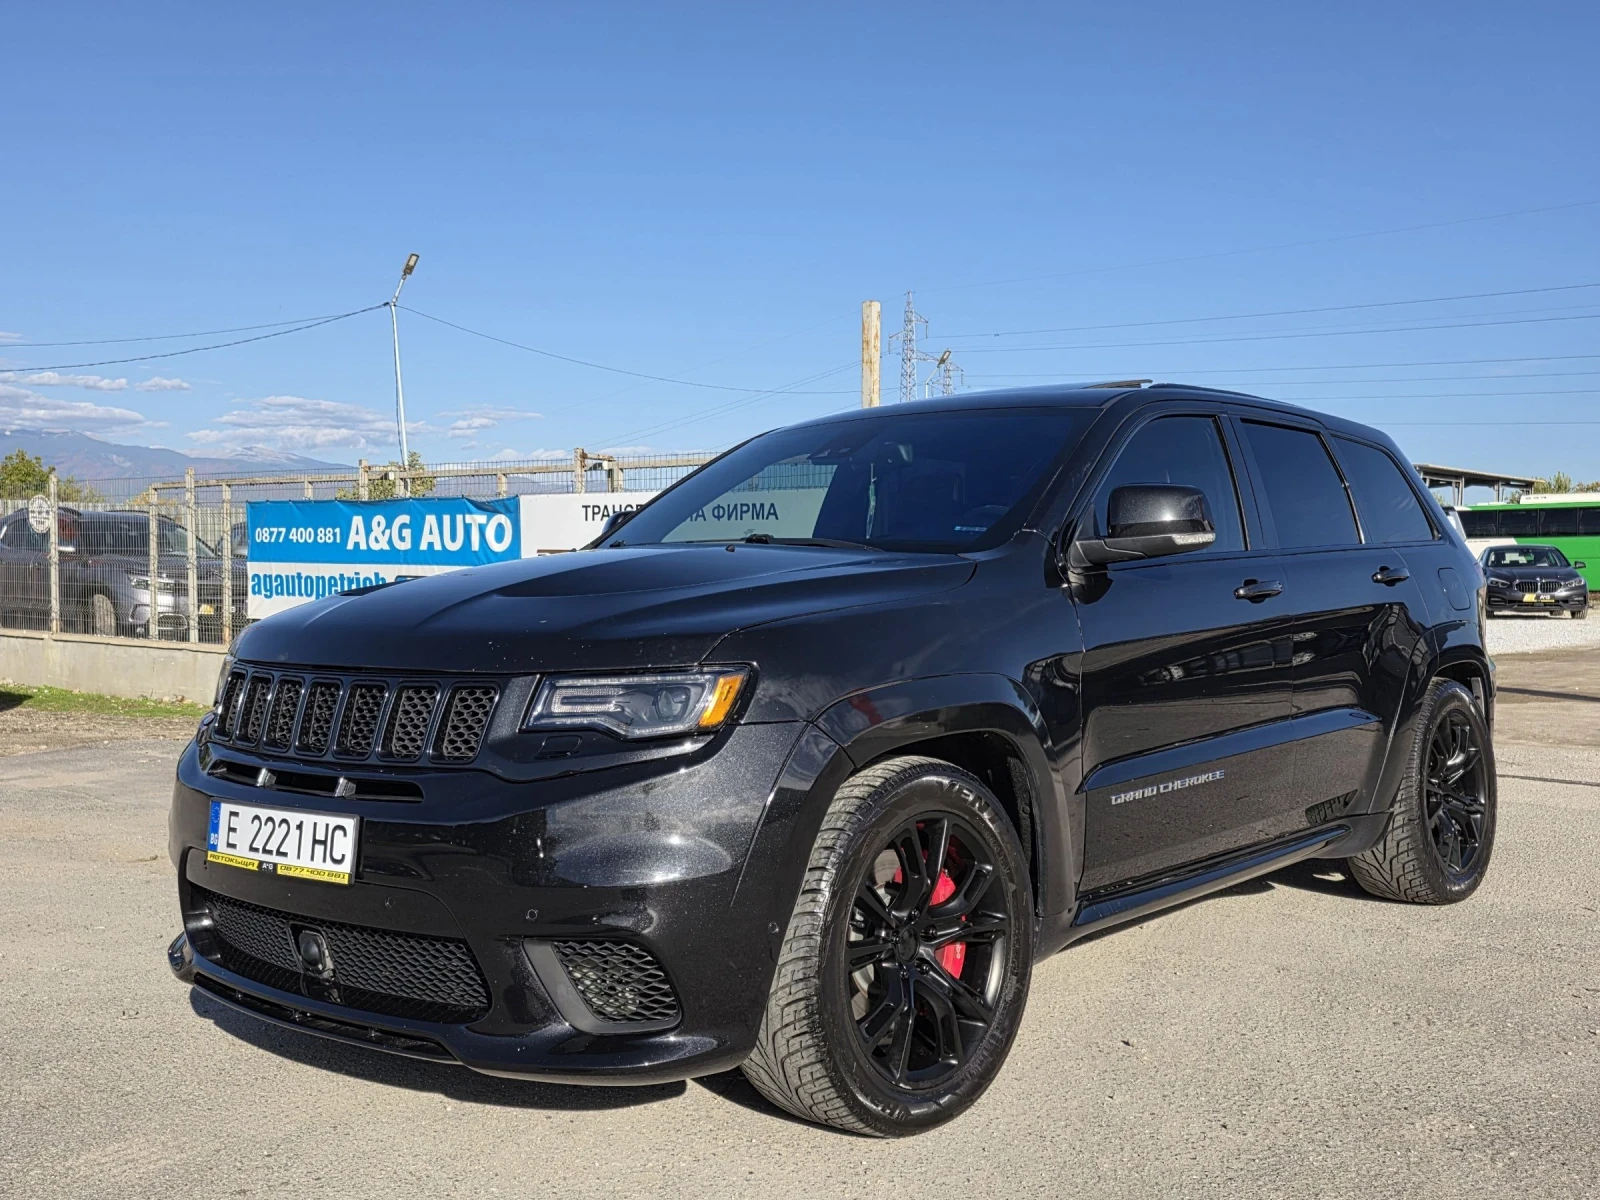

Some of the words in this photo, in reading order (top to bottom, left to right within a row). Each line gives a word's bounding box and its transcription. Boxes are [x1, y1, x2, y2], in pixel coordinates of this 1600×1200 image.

[711, 502, 779, 521] ФИРМА
[255, 527, 286, 543] 0877
[289, 527, 314, 543] 400
[317, 527, 341, 543] 881
[346, 514, 411, 551] A&G
[419, 513, 513, 552] AUTO
[1110, 785, 1157, 805] GRAND
[1159, 769, 1225, 793] CHEROKEE
[210, 832, 218, 846] BG
[226, 810, 240, 850] E
[279, 864, 305, 873] 0877
[306, 868, 326, 877] 400
[326, 872, 346, 880] 881
